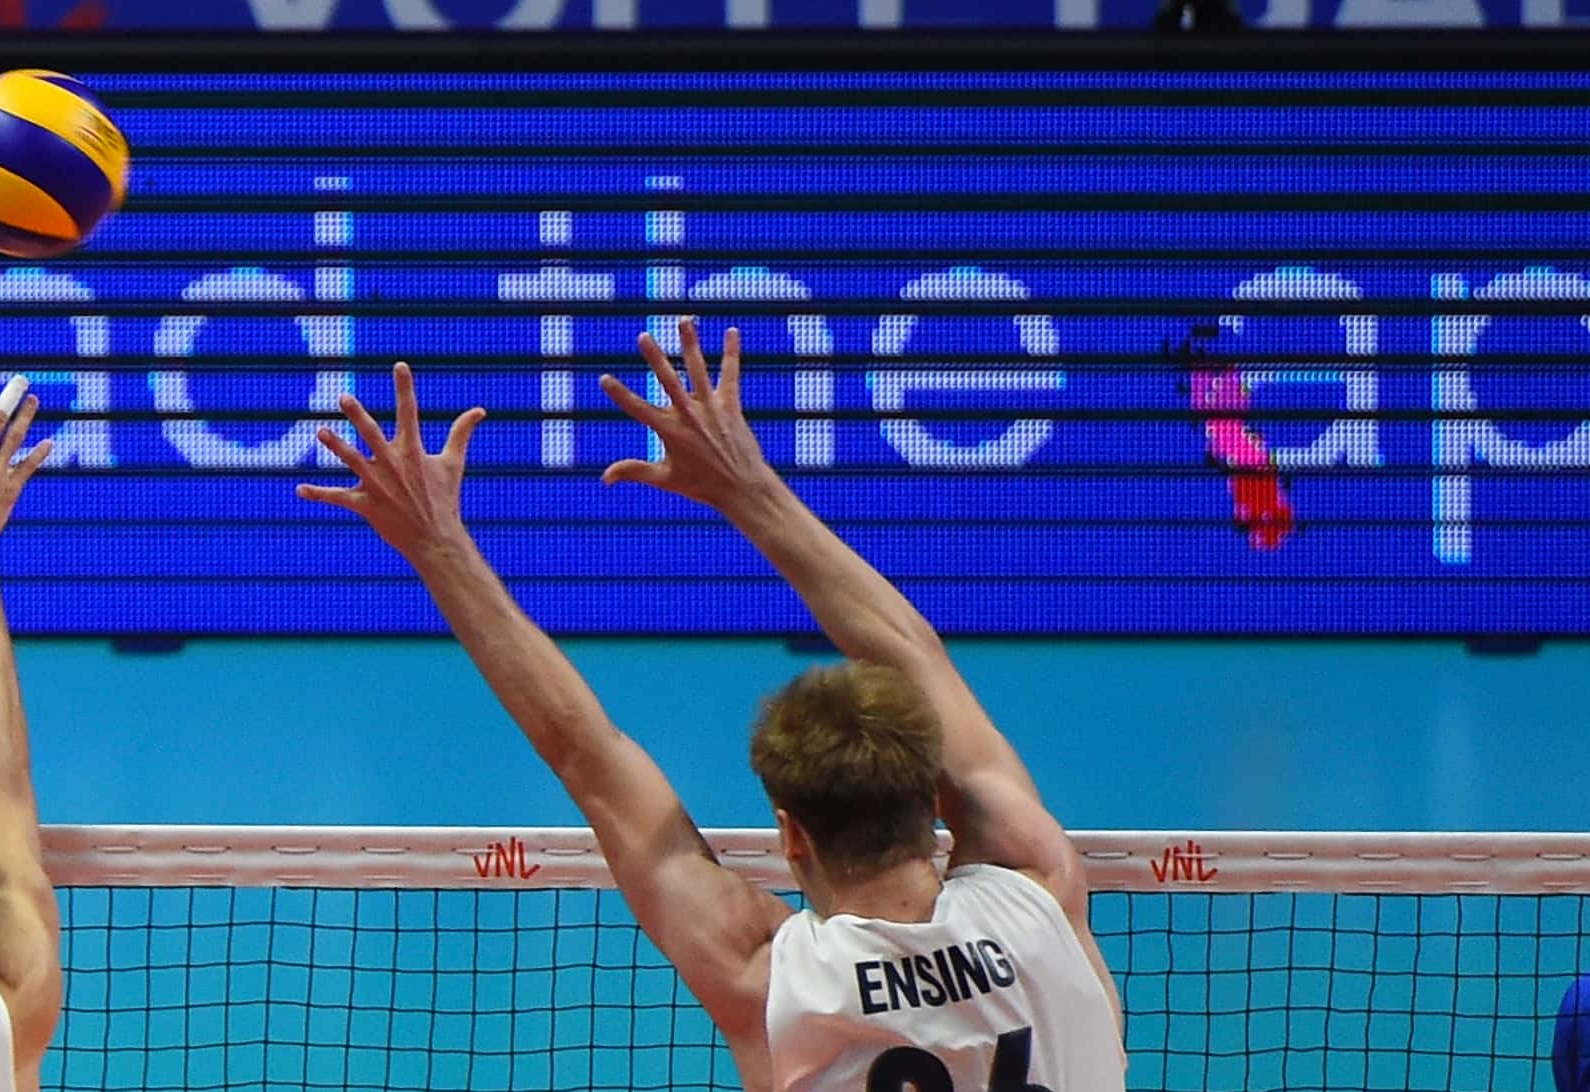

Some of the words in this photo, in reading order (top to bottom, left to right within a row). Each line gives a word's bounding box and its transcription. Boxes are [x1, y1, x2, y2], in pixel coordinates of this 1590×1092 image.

[497, 176, 1066, 468] the
[473, 836, 541, 879] VNL
[1151, 840, 1218, 882] VNL
[855, 938, 1016, 1015] ENSING
